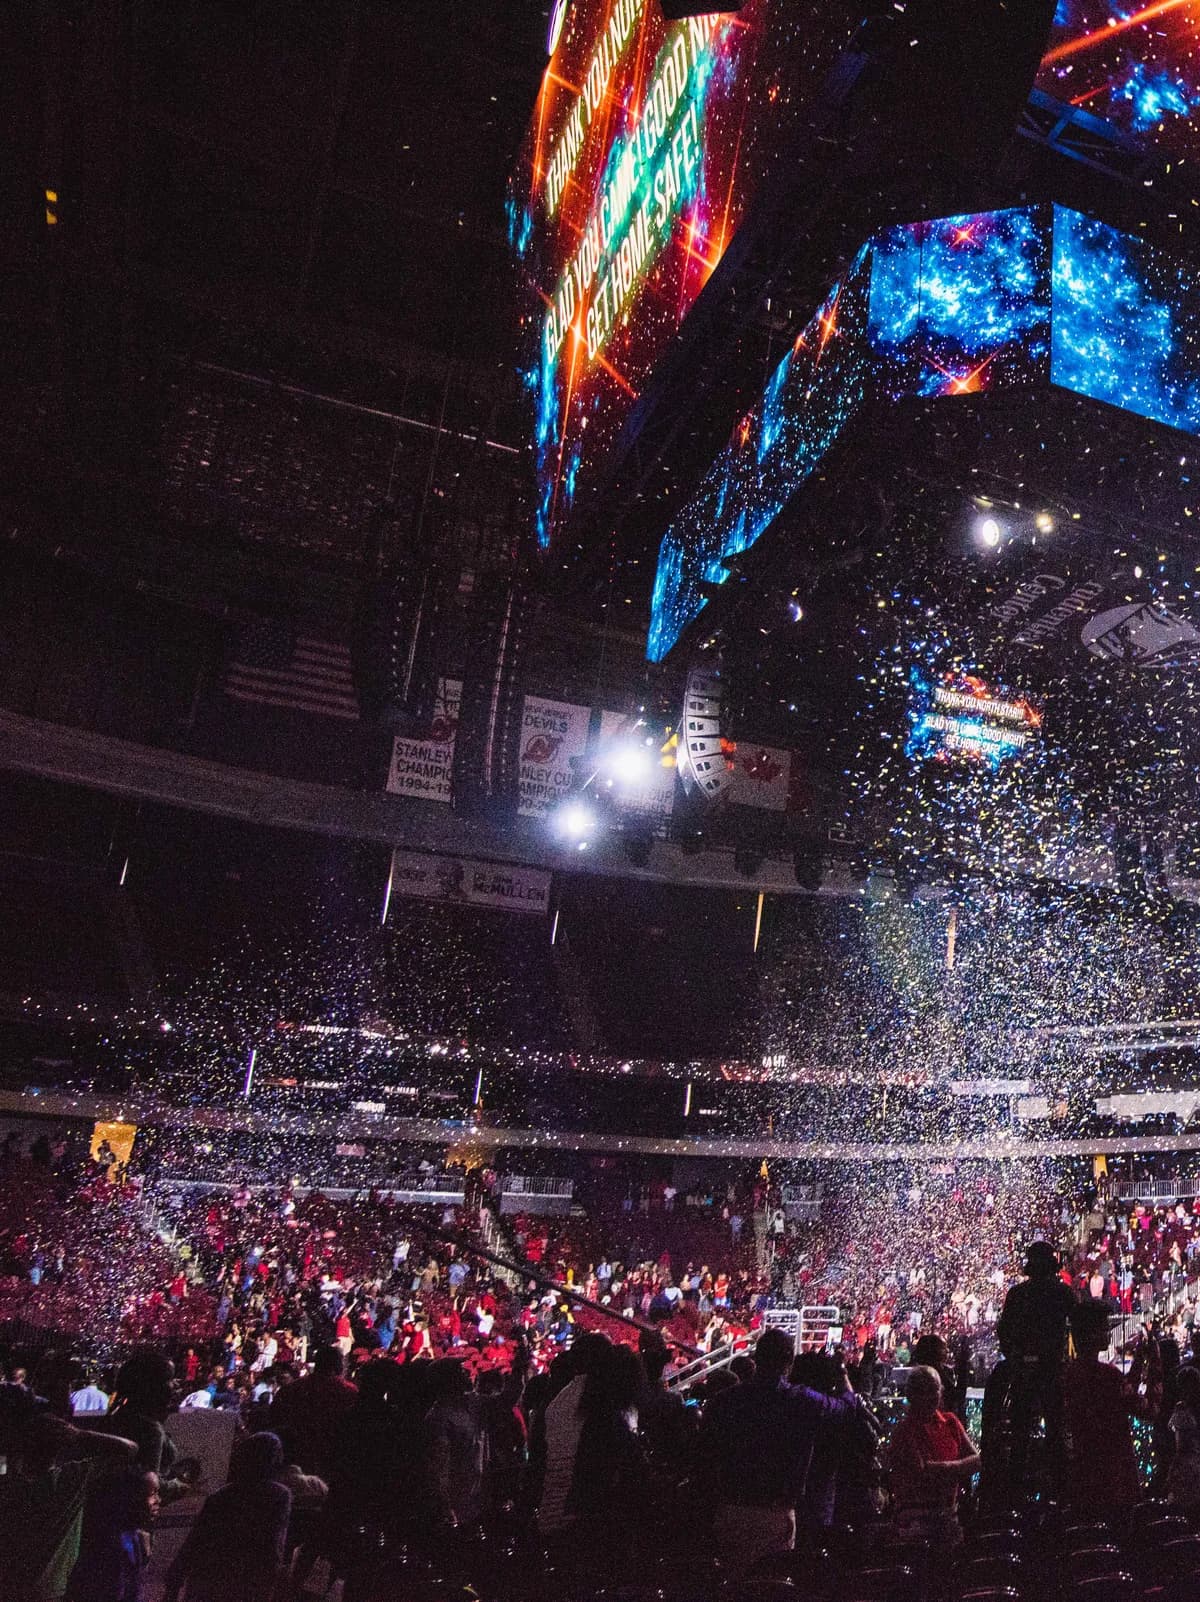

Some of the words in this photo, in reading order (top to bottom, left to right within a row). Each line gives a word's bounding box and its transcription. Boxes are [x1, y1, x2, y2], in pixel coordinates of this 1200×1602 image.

[546, 95, 584, 214] THANK
[546, 273, 576, 363] GLAD
[574, 216, 601, 300] YOU
[601, 124, 643, 249] CAME!
[643, 33, 688, 158] GOOD
[688, 14, 720, 67] NI
[586, 277, 610, 360] GET
[611, 187, 654, 314] HOME
[653, 101, 700, 229] SAFE!
[990, 574, 1066, 623] Center
[525, 714, 568, 733] DEVILS
[935, 688, 960, 708] THANK
[976, 699, 1000, 714] NORTH
[396, 742, 451, 763] STANLEY
